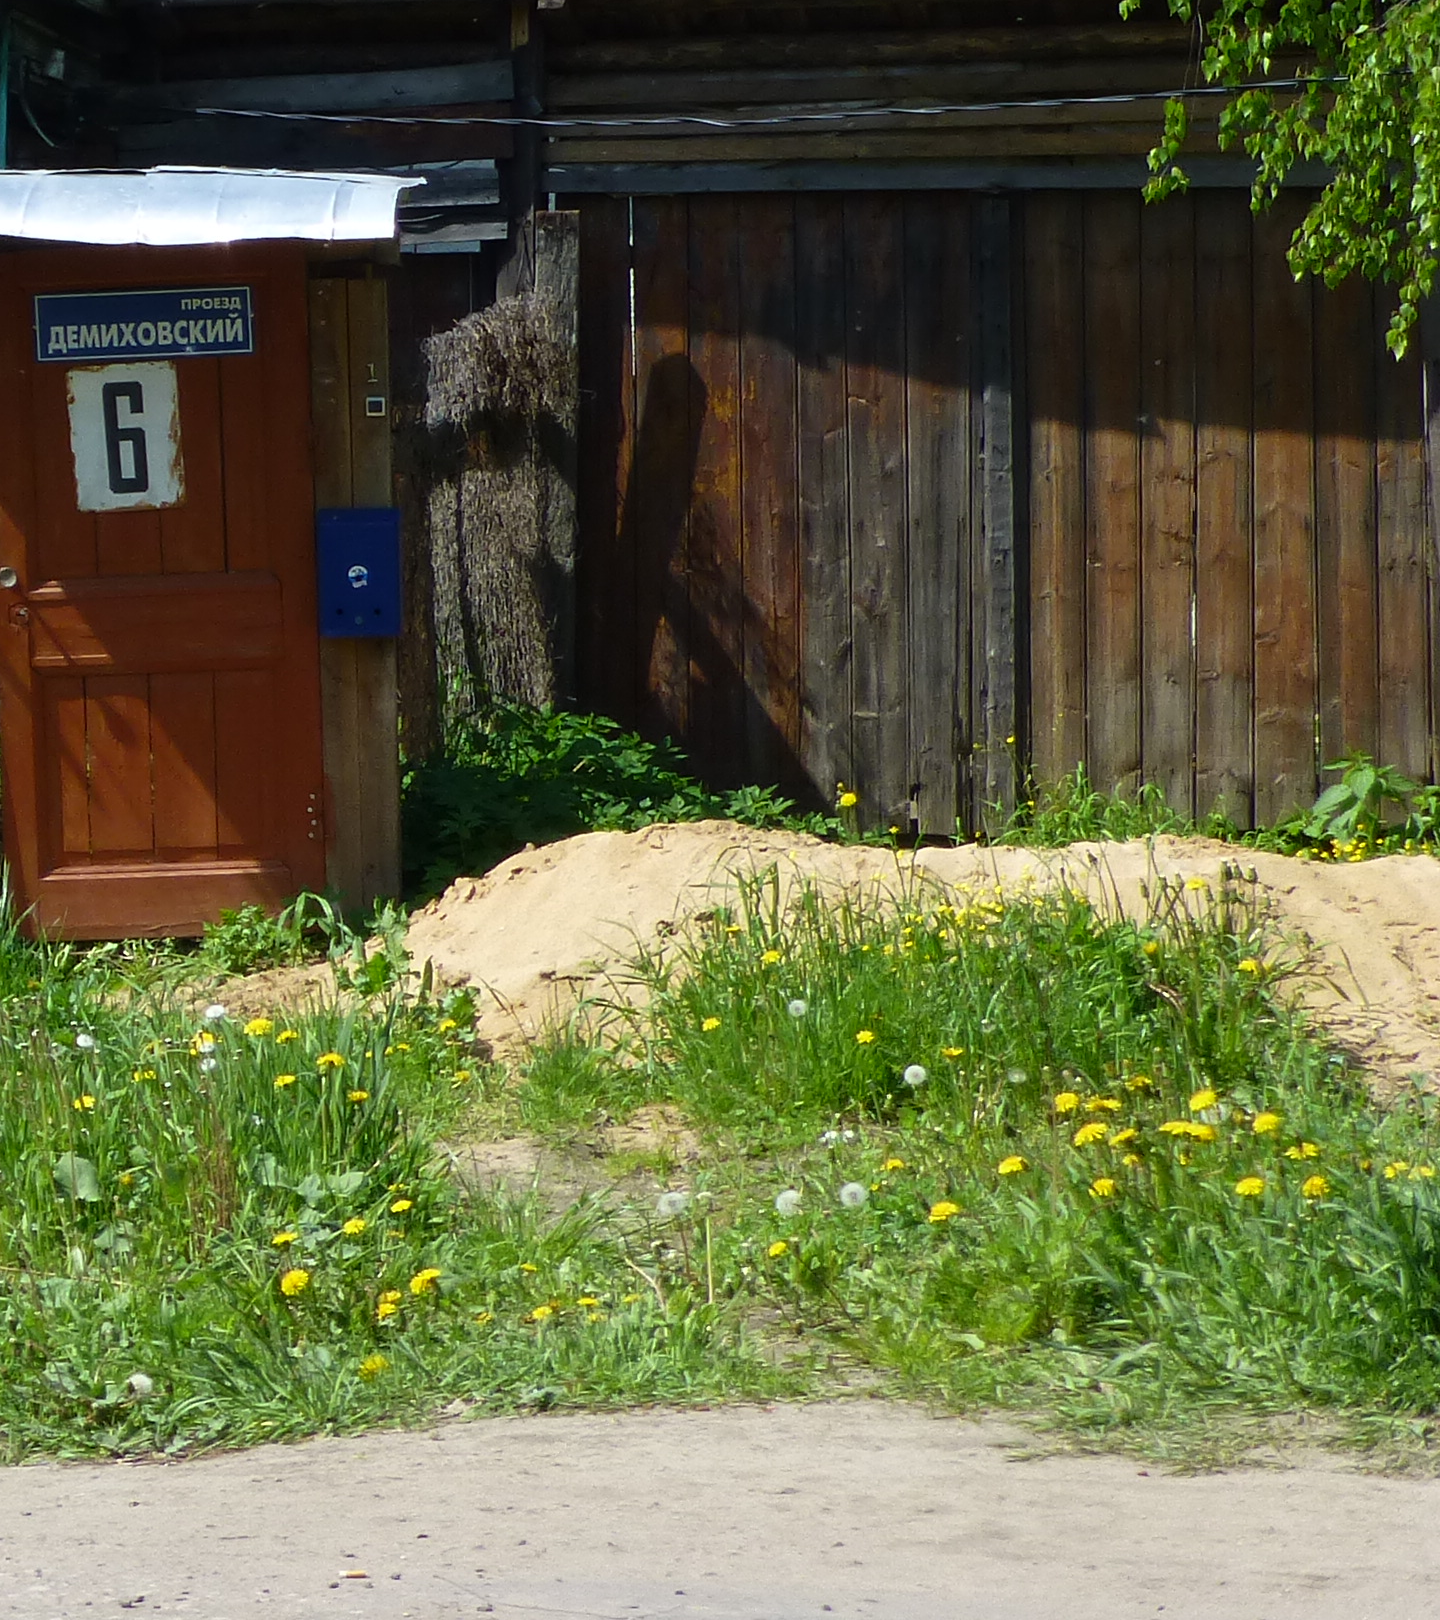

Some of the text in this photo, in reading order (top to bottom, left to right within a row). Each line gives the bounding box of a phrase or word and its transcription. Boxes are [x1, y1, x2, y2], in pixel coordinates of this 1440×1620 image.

[181, 296, 242, 310] ПРОЕЗД
[48, 313, 243, 354] ДЕМИХОВСКИЙ
[102, 381, 149, 494] 6
